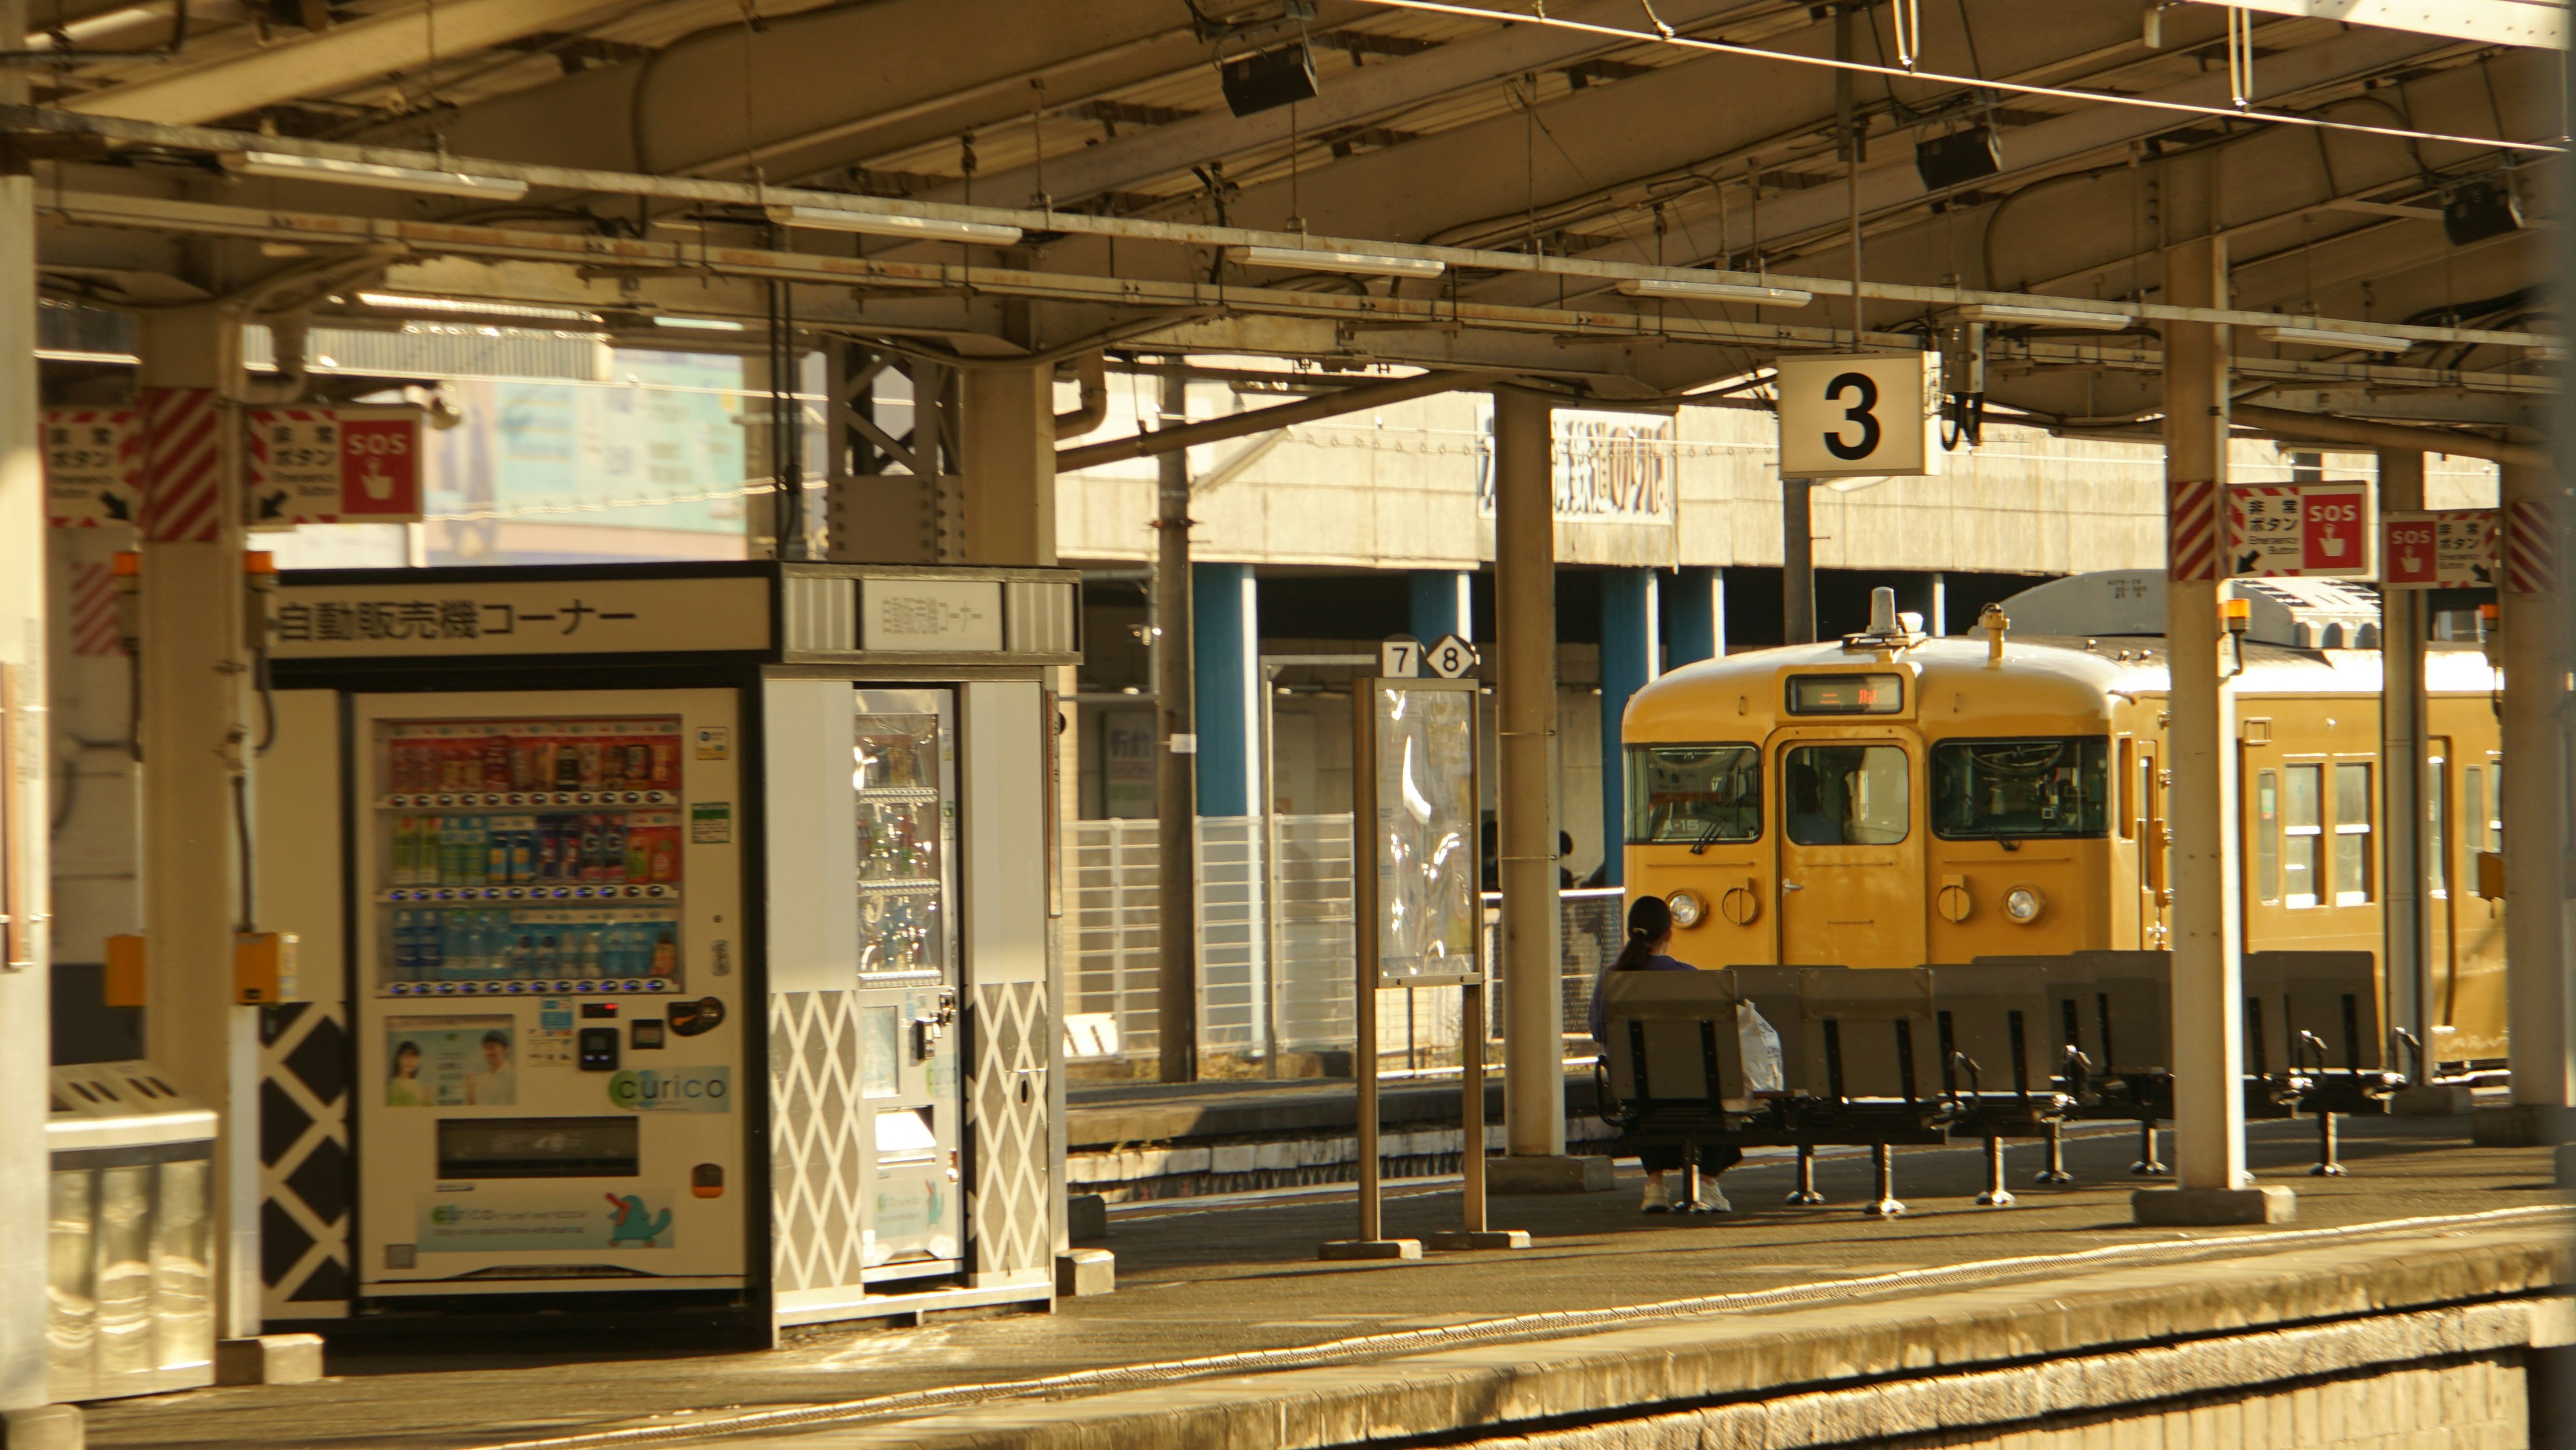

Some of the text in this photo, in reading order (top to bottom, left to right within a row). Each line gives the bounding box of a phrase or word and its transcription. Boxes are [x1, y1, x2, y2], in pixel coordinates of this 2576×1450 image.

[1823, 372, 1881, 461] 3
[348, 433, 408, 456] SOS
[274, 448, 336, 467] ボタン
[2249, 499, 2297, 515] 非常
[2308, 504, 2357, 522] SOS
[2249, 518, 2298, 532] ボタン
[2391, 530, 2431, 545] SOS
[279, 598, 637, 641] 自動販売機コーナー
[1392, 648, 1408, 673] 7
[1443, 648, 1458, 672] 8
[1663, 820, 1699, 831] A-15
[617, 1075, 726, 1099] curico
